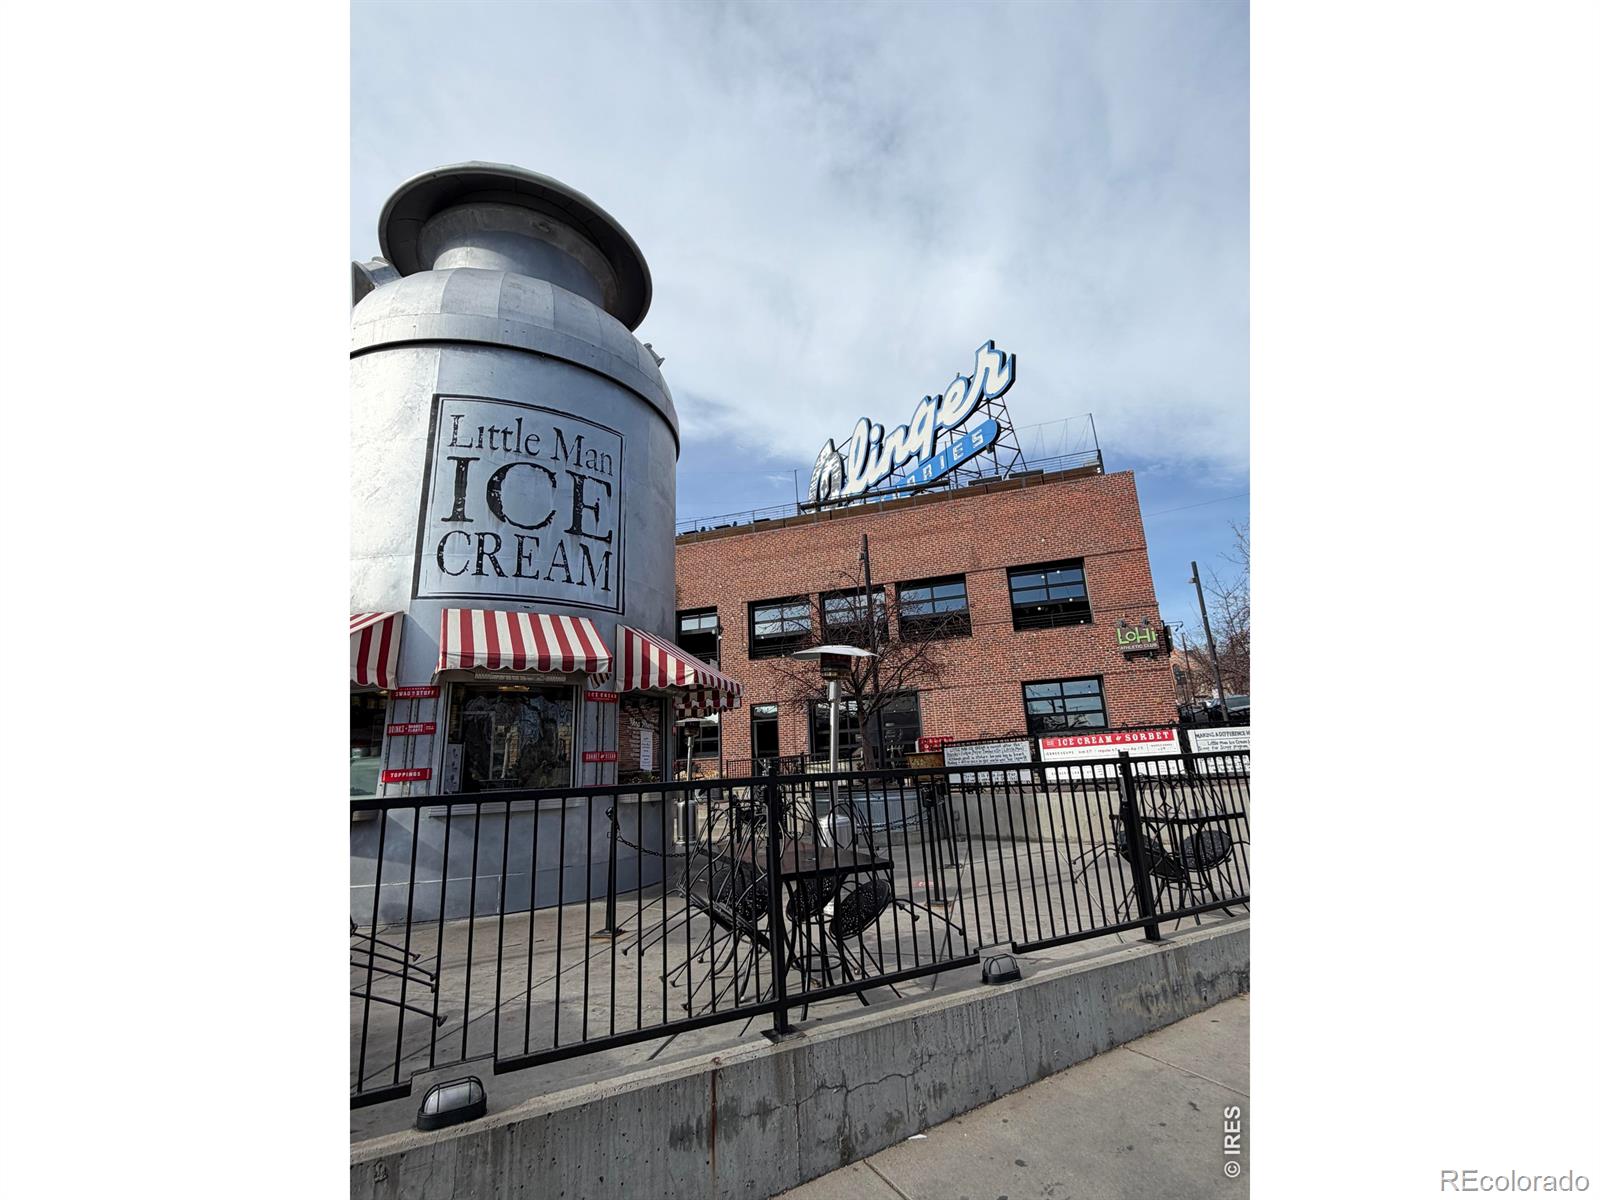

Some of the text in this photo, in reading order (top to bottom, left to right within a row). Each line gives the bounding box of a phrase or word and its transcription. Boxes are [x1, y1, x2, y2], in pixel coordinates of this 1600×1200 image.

[447, 414, 613, 476] Little Man
[441, 456, 613, 544] ICE
[437, 530, 613, 592] CREAM
[1057, 737, 1074, 747] ICE
[1077, 735, 1112, 745] CREAM
[1125, 731, 1169, 742] SORBET
